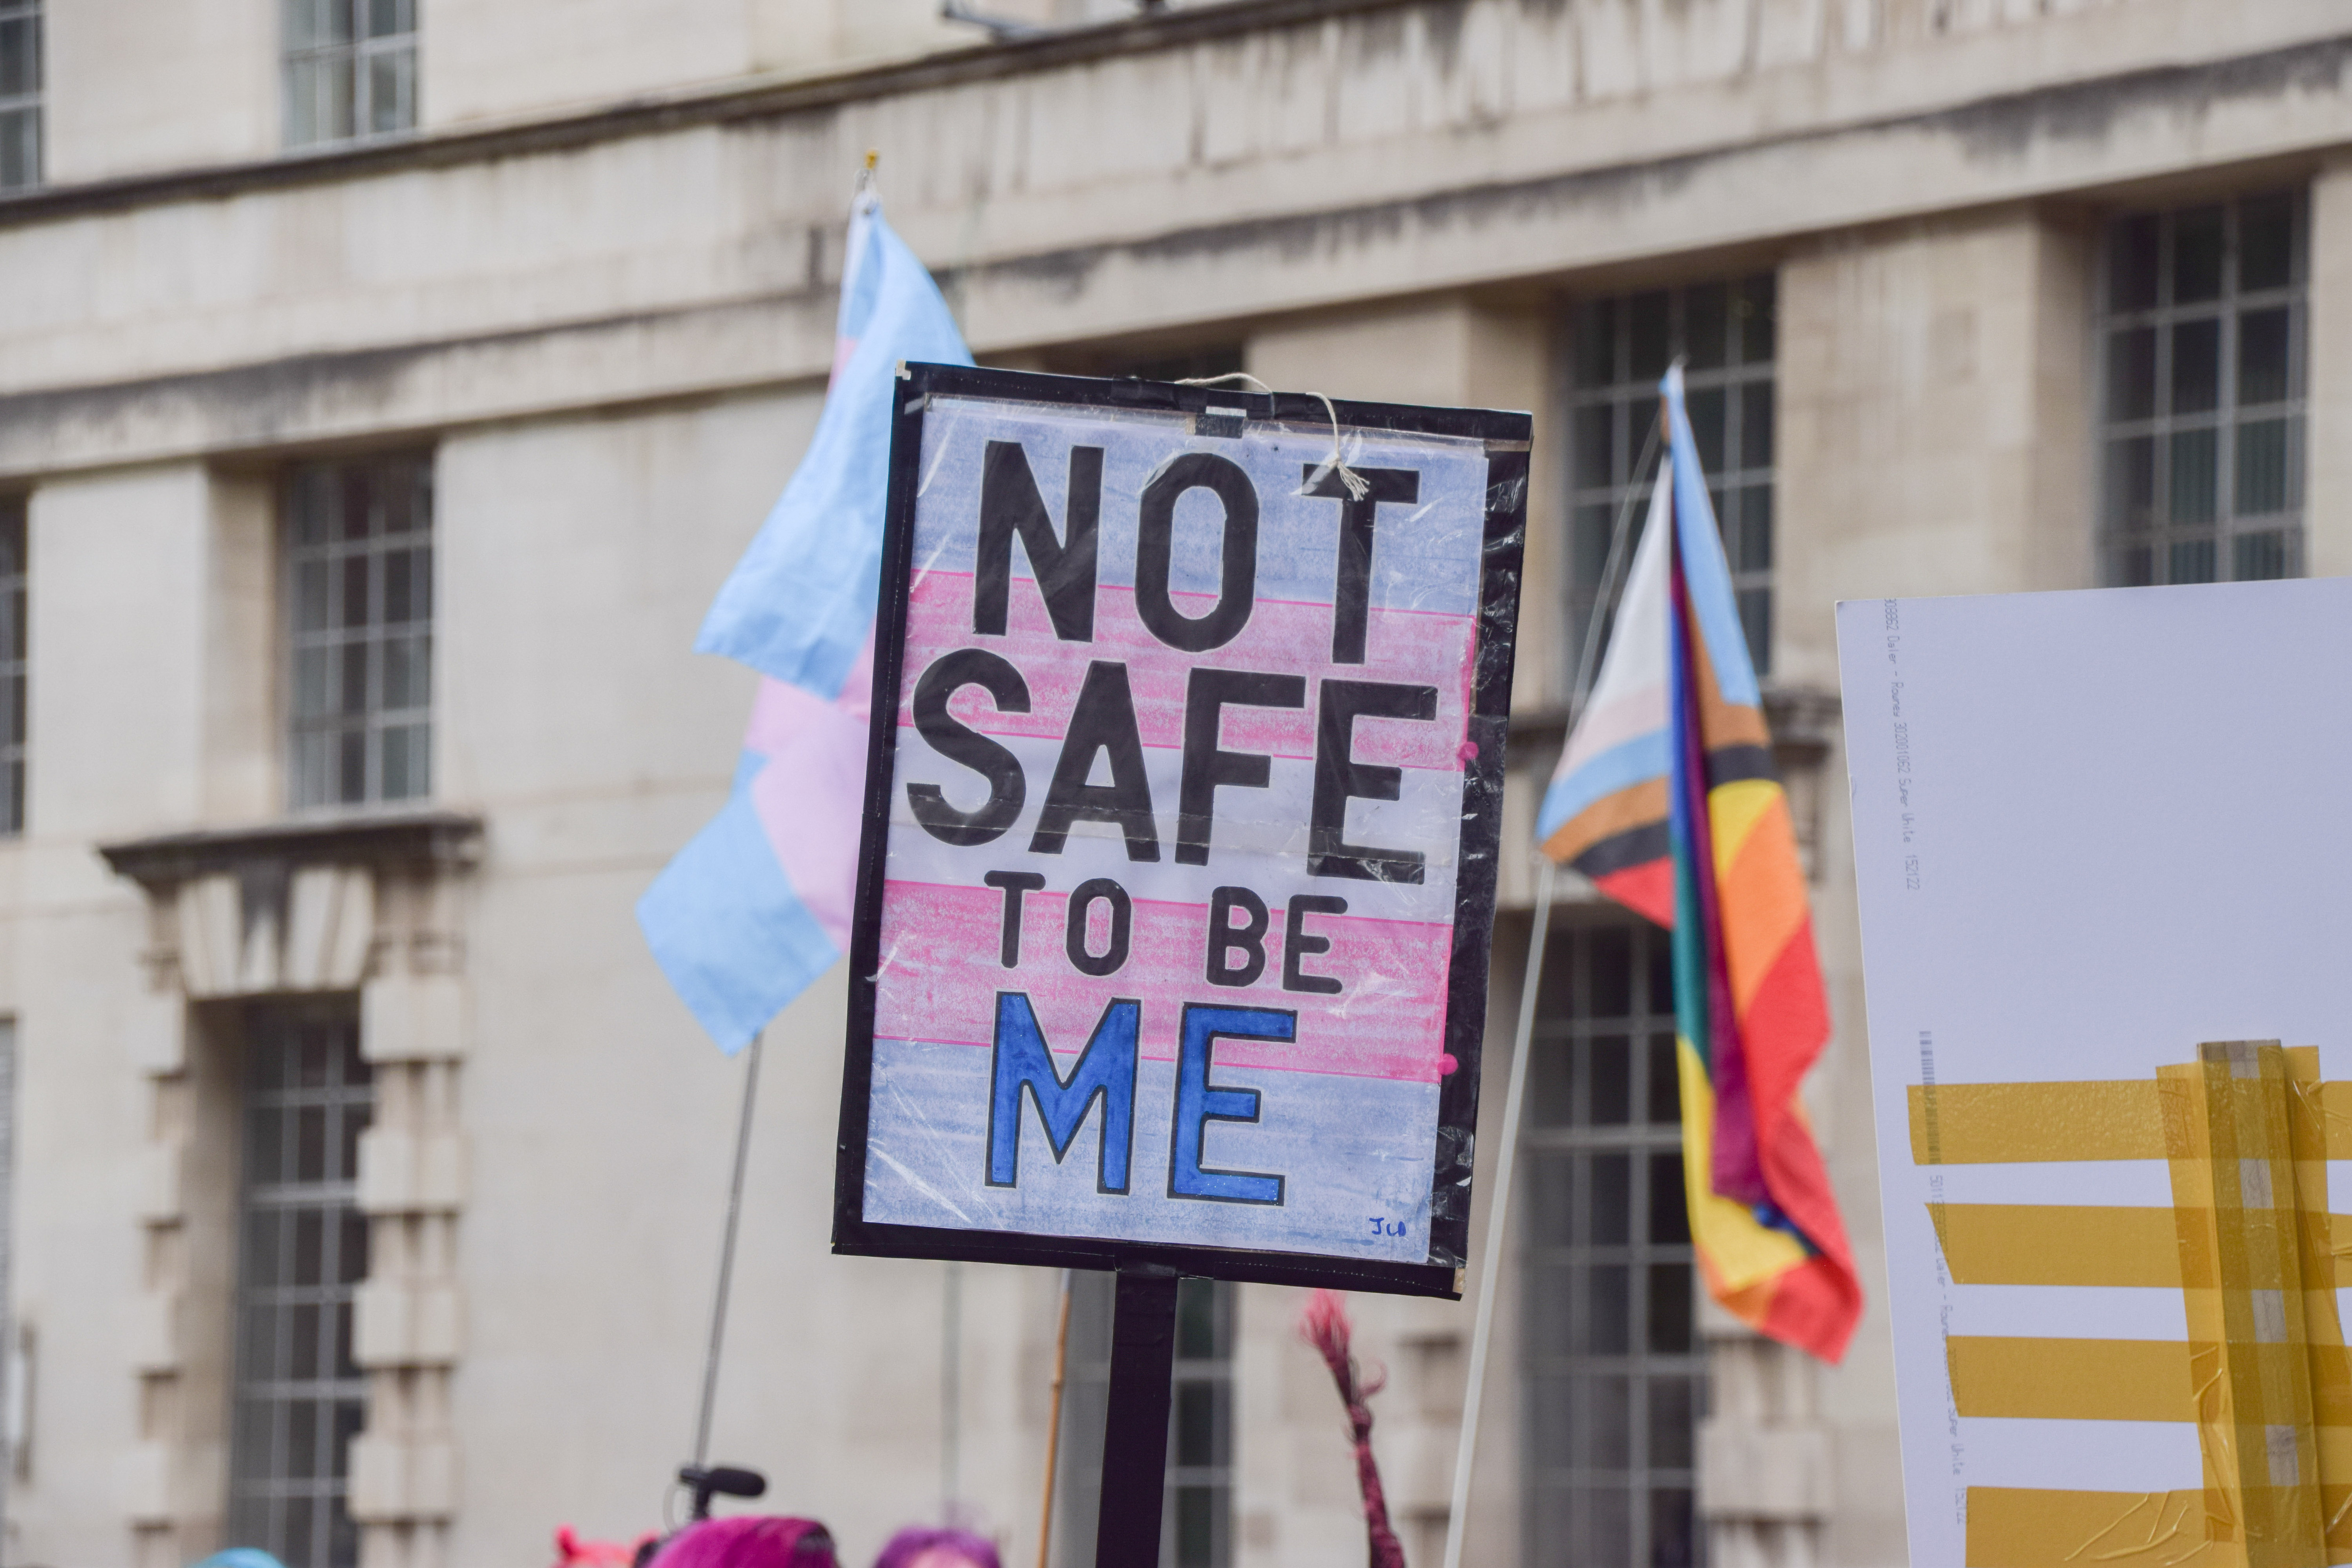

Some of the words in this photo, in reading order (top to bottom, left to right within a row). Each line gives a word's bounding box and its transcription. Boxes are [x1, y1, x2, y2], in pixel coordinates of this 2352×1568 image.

[972, 439, 1419, 664] NOT
[906, 648, 1438, 885] SAFE
[1887, 635, 1900, 664] Daler
[1899, 779, 1912, 806] Super
[985, 870, 1133, 976] TO
[1206, 885, 1348, 995] BE
[985, 991, 1297, 1207] ME
